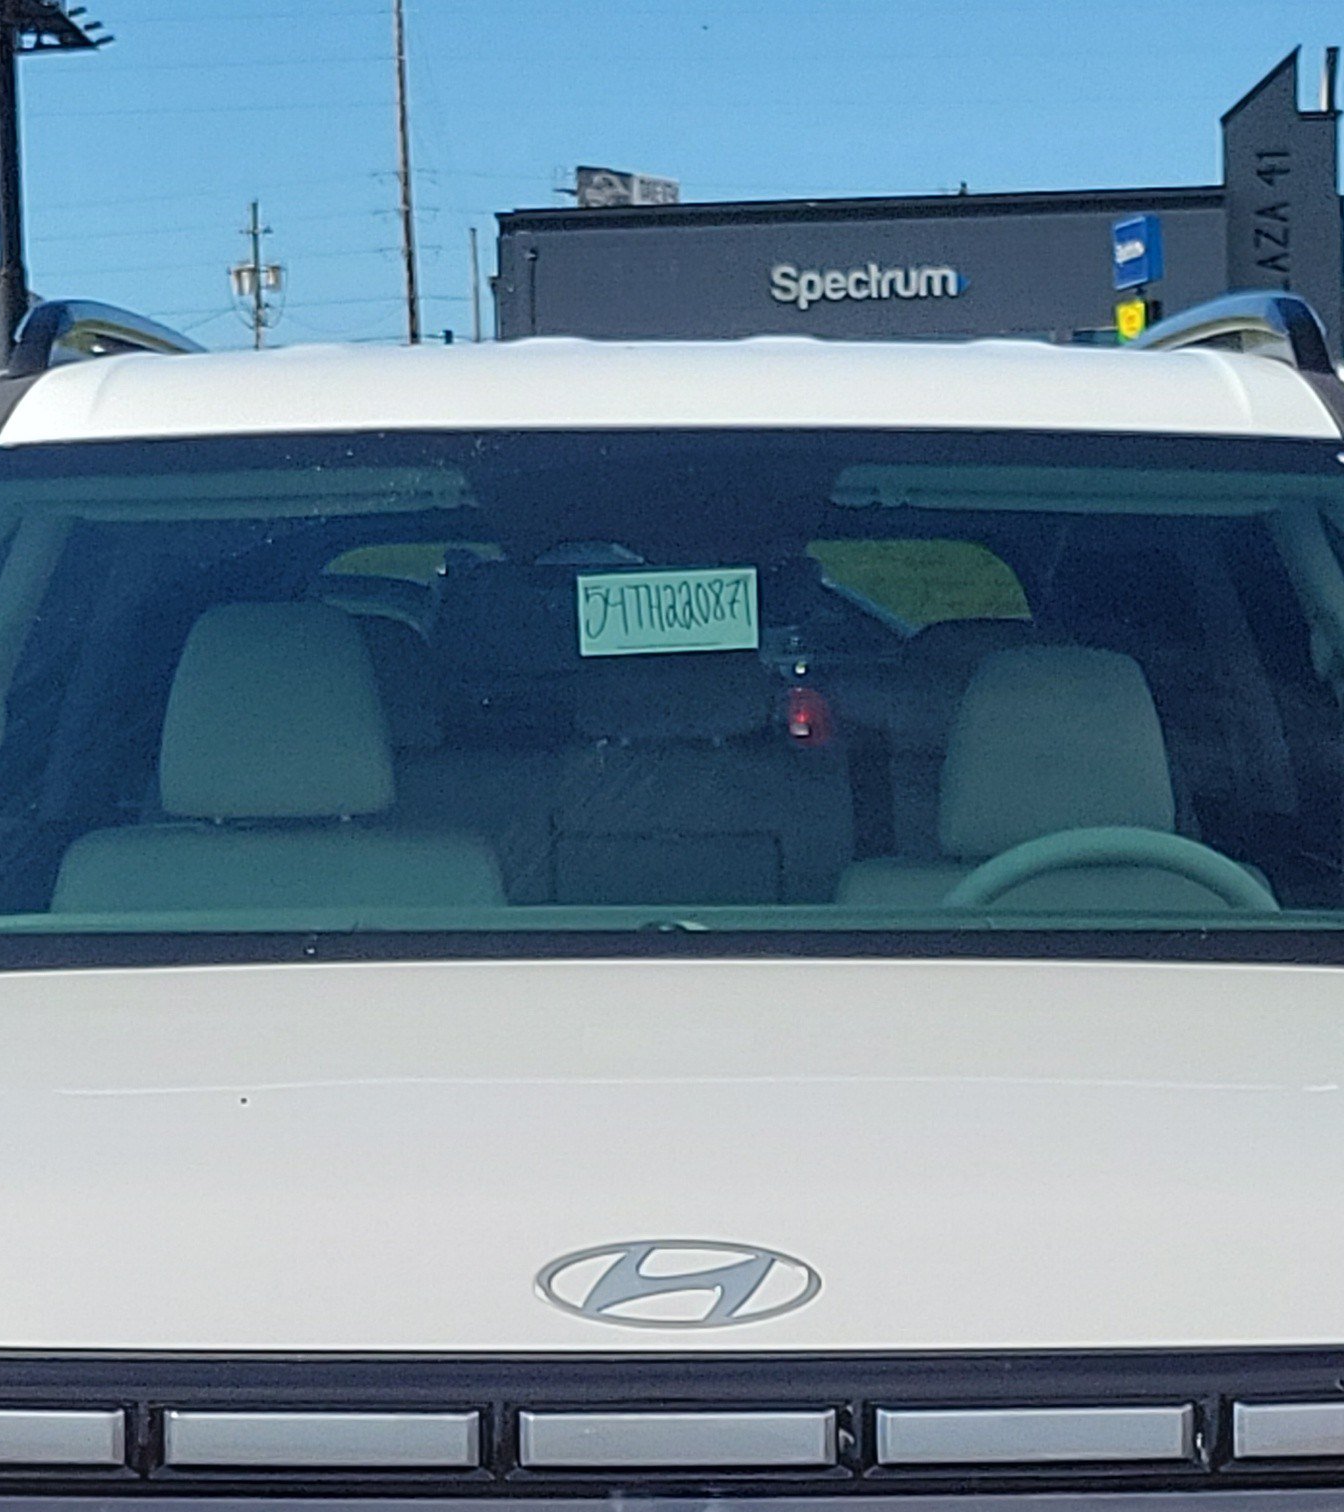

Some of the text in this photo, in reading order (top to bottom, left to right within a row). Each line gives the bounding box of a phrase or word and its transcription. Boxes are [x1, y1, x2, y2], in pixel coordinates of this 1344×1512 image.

[1254, 152, 1291, 292] AZA 41
[770, 263, 957, 311] Spectrum
[584, 579, 753, 640] 54TH220871
